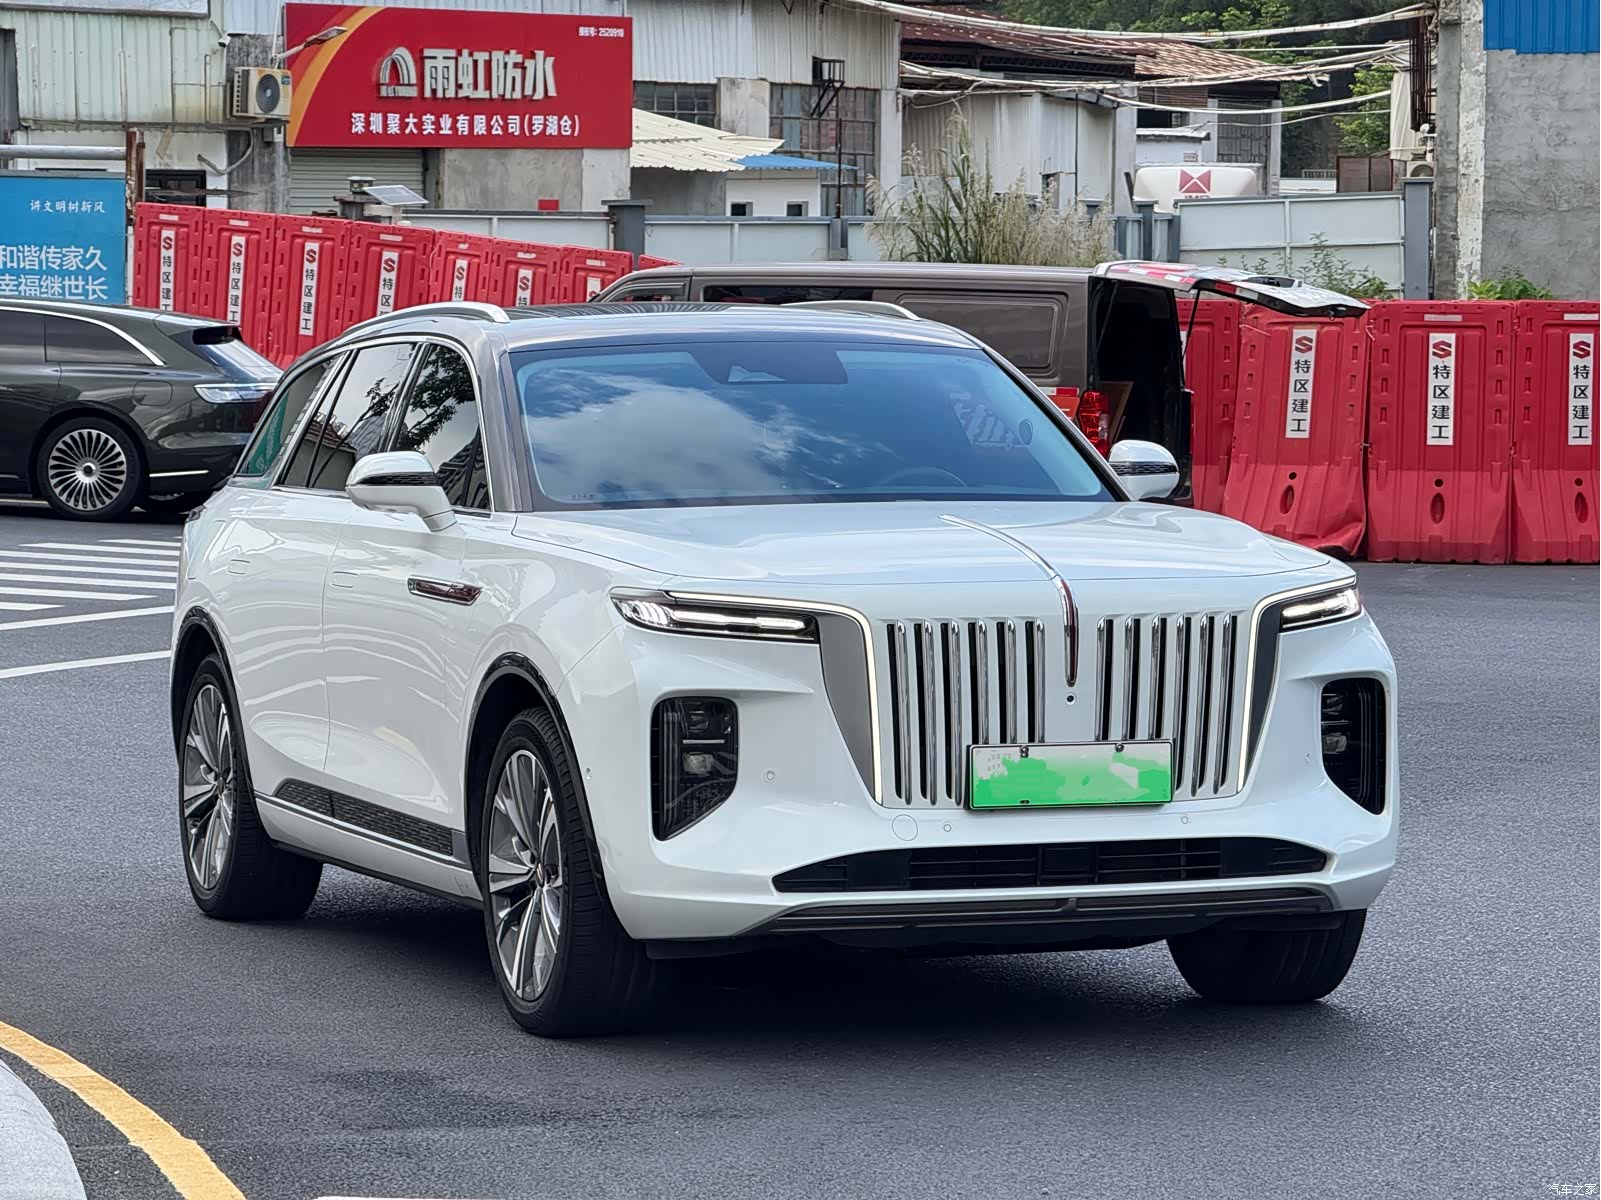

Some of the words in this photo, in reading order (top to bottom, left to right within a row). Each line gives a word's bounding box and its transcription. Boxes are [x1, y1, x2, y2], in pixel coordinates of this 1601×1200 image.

[423, 48, 557, 100] 雨虹防水
[29, 199, 105, 213] 讲文明树新风
[0, 244, 108, 271] 和谐传家久
[0, 273, 108, 300] 幸福继世长
[229, 261, 242, 323] 特区建工
[301, 268, 315, 331] 特区建工
[1290, 359, 1311, 432] 特区建工
[1431, 364, 1451, 439] 特区建工
[1572, 364, 1590, 439] 特区建工
